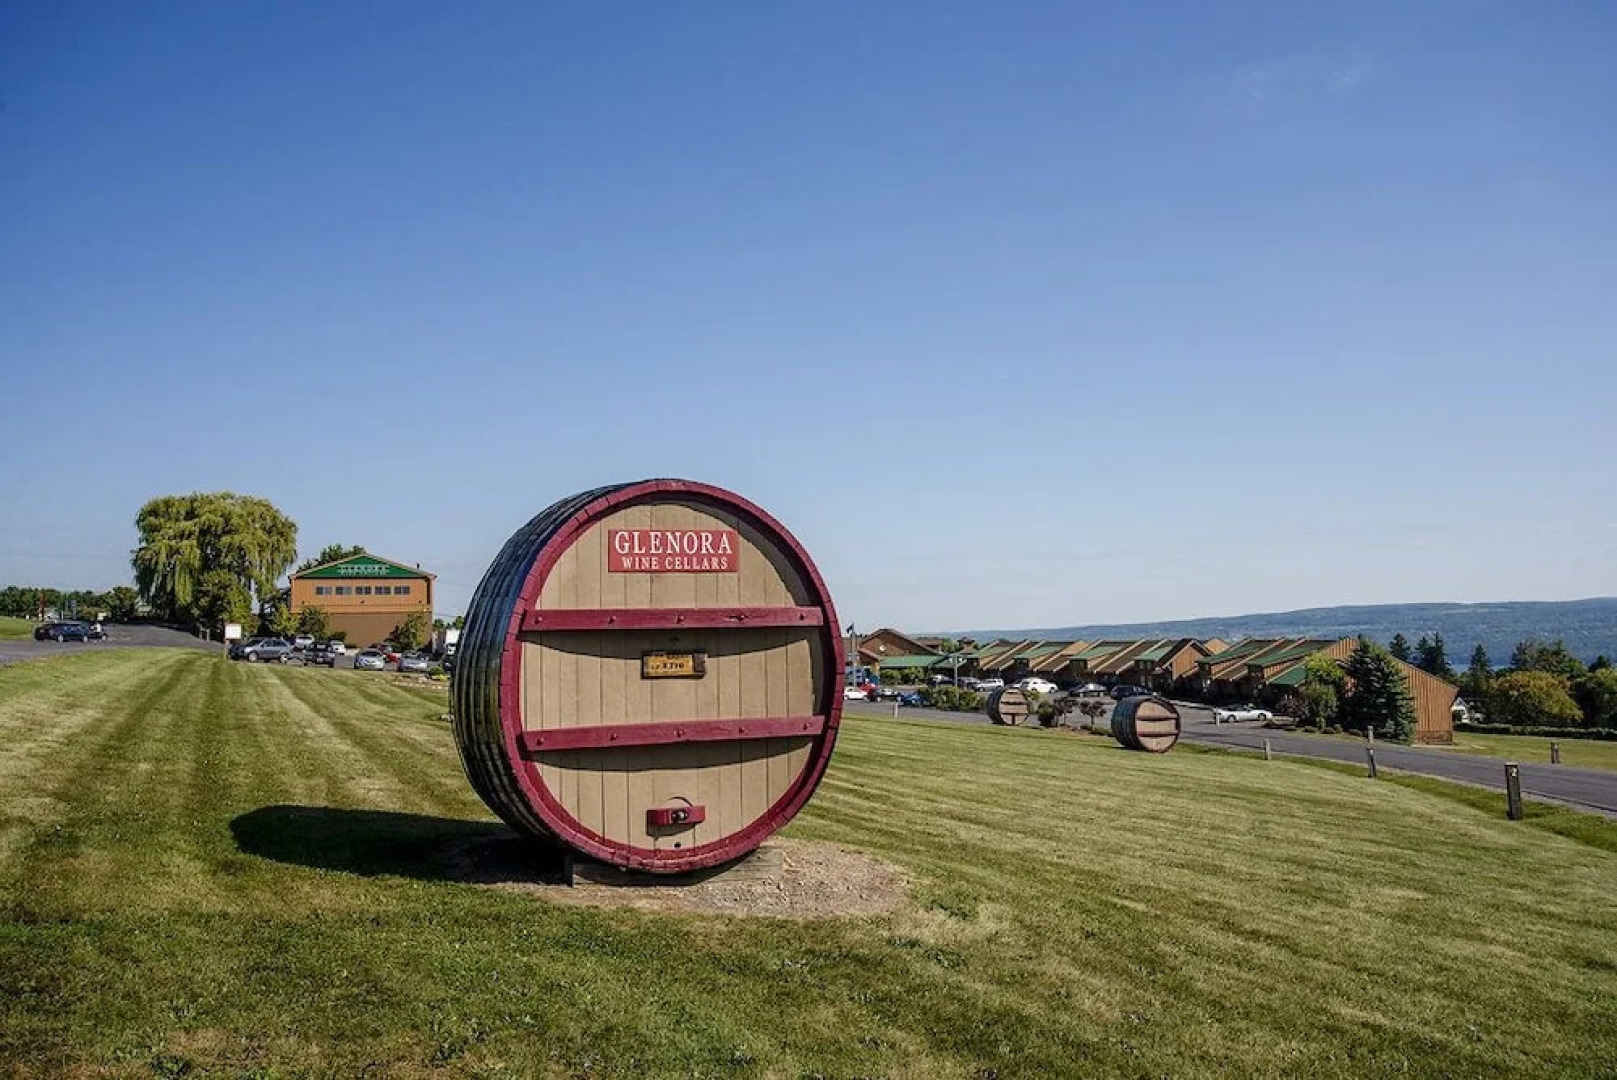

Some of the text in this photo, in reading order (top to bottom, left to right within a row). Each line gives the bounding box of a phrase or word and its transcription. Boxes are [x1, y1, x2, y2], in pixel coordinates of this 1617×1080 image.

[615, 531, 732, 554] GLENORA
[622, 557, 728, 570] WINE CELLARS
